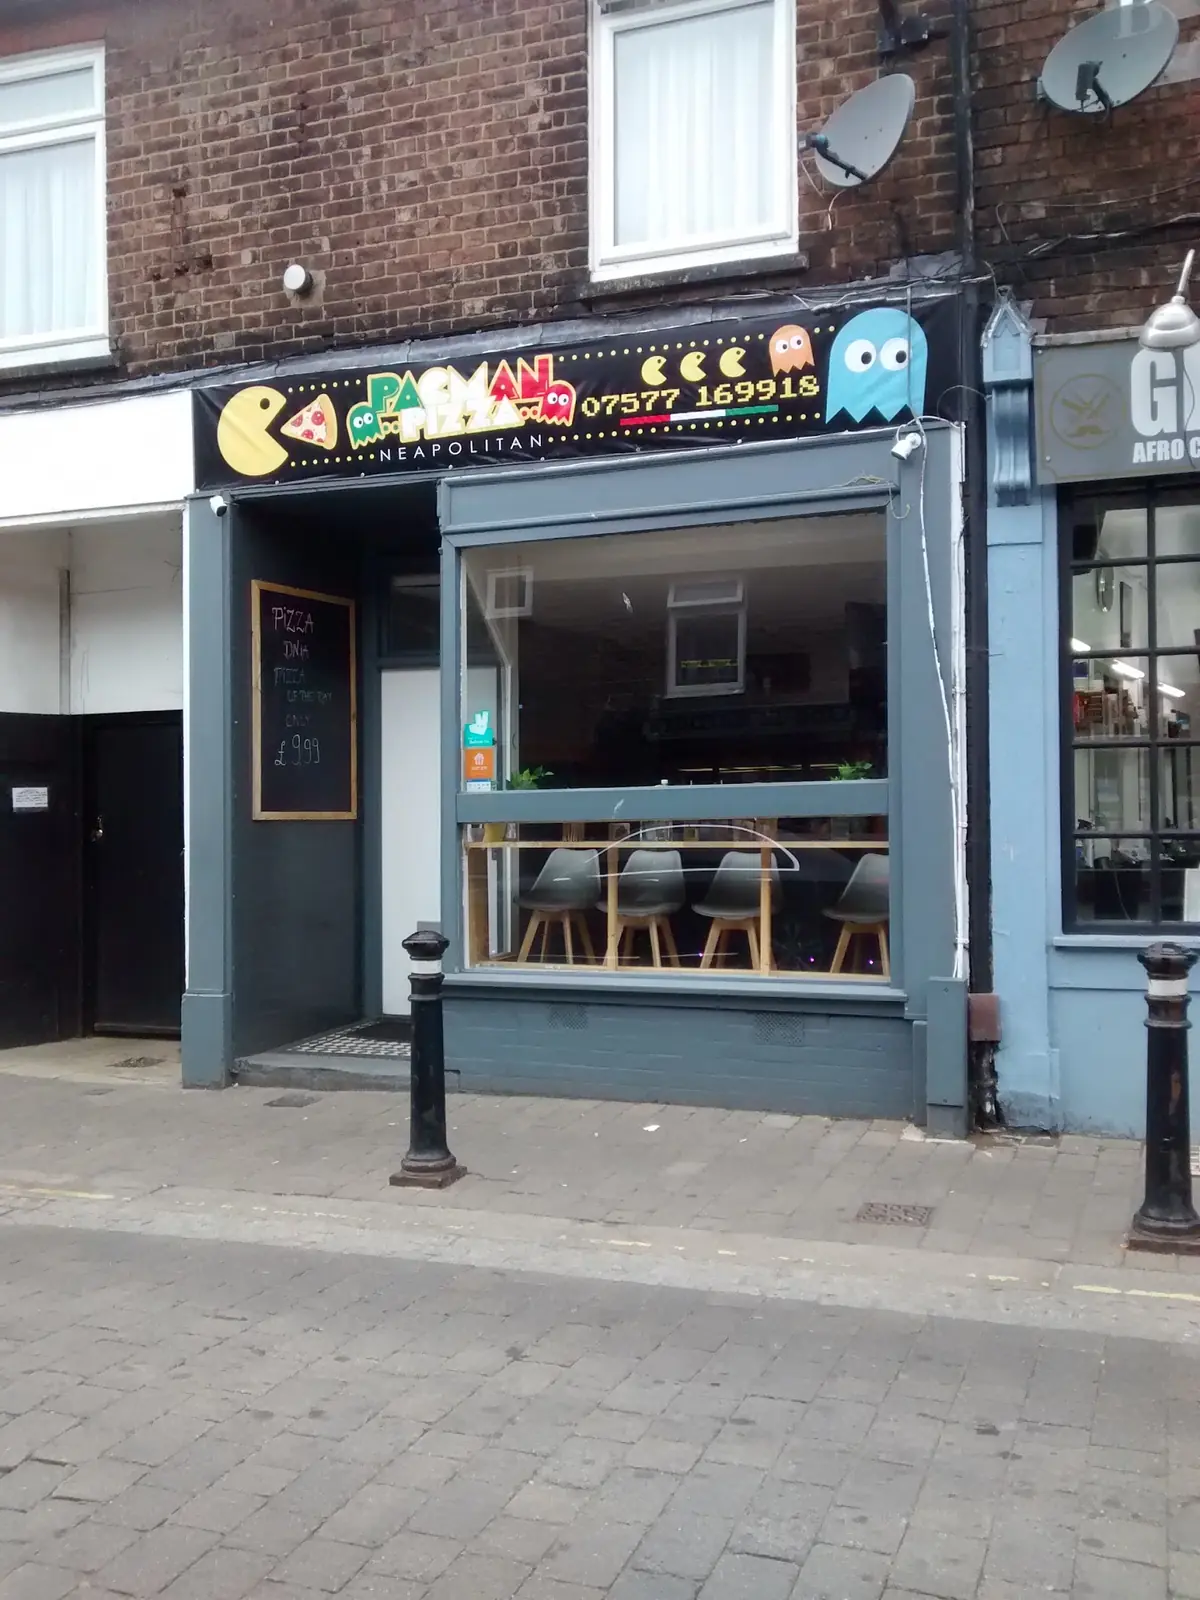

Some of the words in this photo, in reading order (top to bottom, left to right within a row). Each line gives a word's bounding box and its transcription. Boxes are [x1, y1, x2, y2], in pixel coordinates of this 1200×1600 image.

[367, 354, 554, 414] PACMAN
[581, 388, 681, 417] 07577
[696, 375, 820, 407] 169918
[400, 395, 526, 444] PIZZA
[379, 434, 543, 462] NEAPOLITAN
[1132, 438, 1185, 464] AFRO
